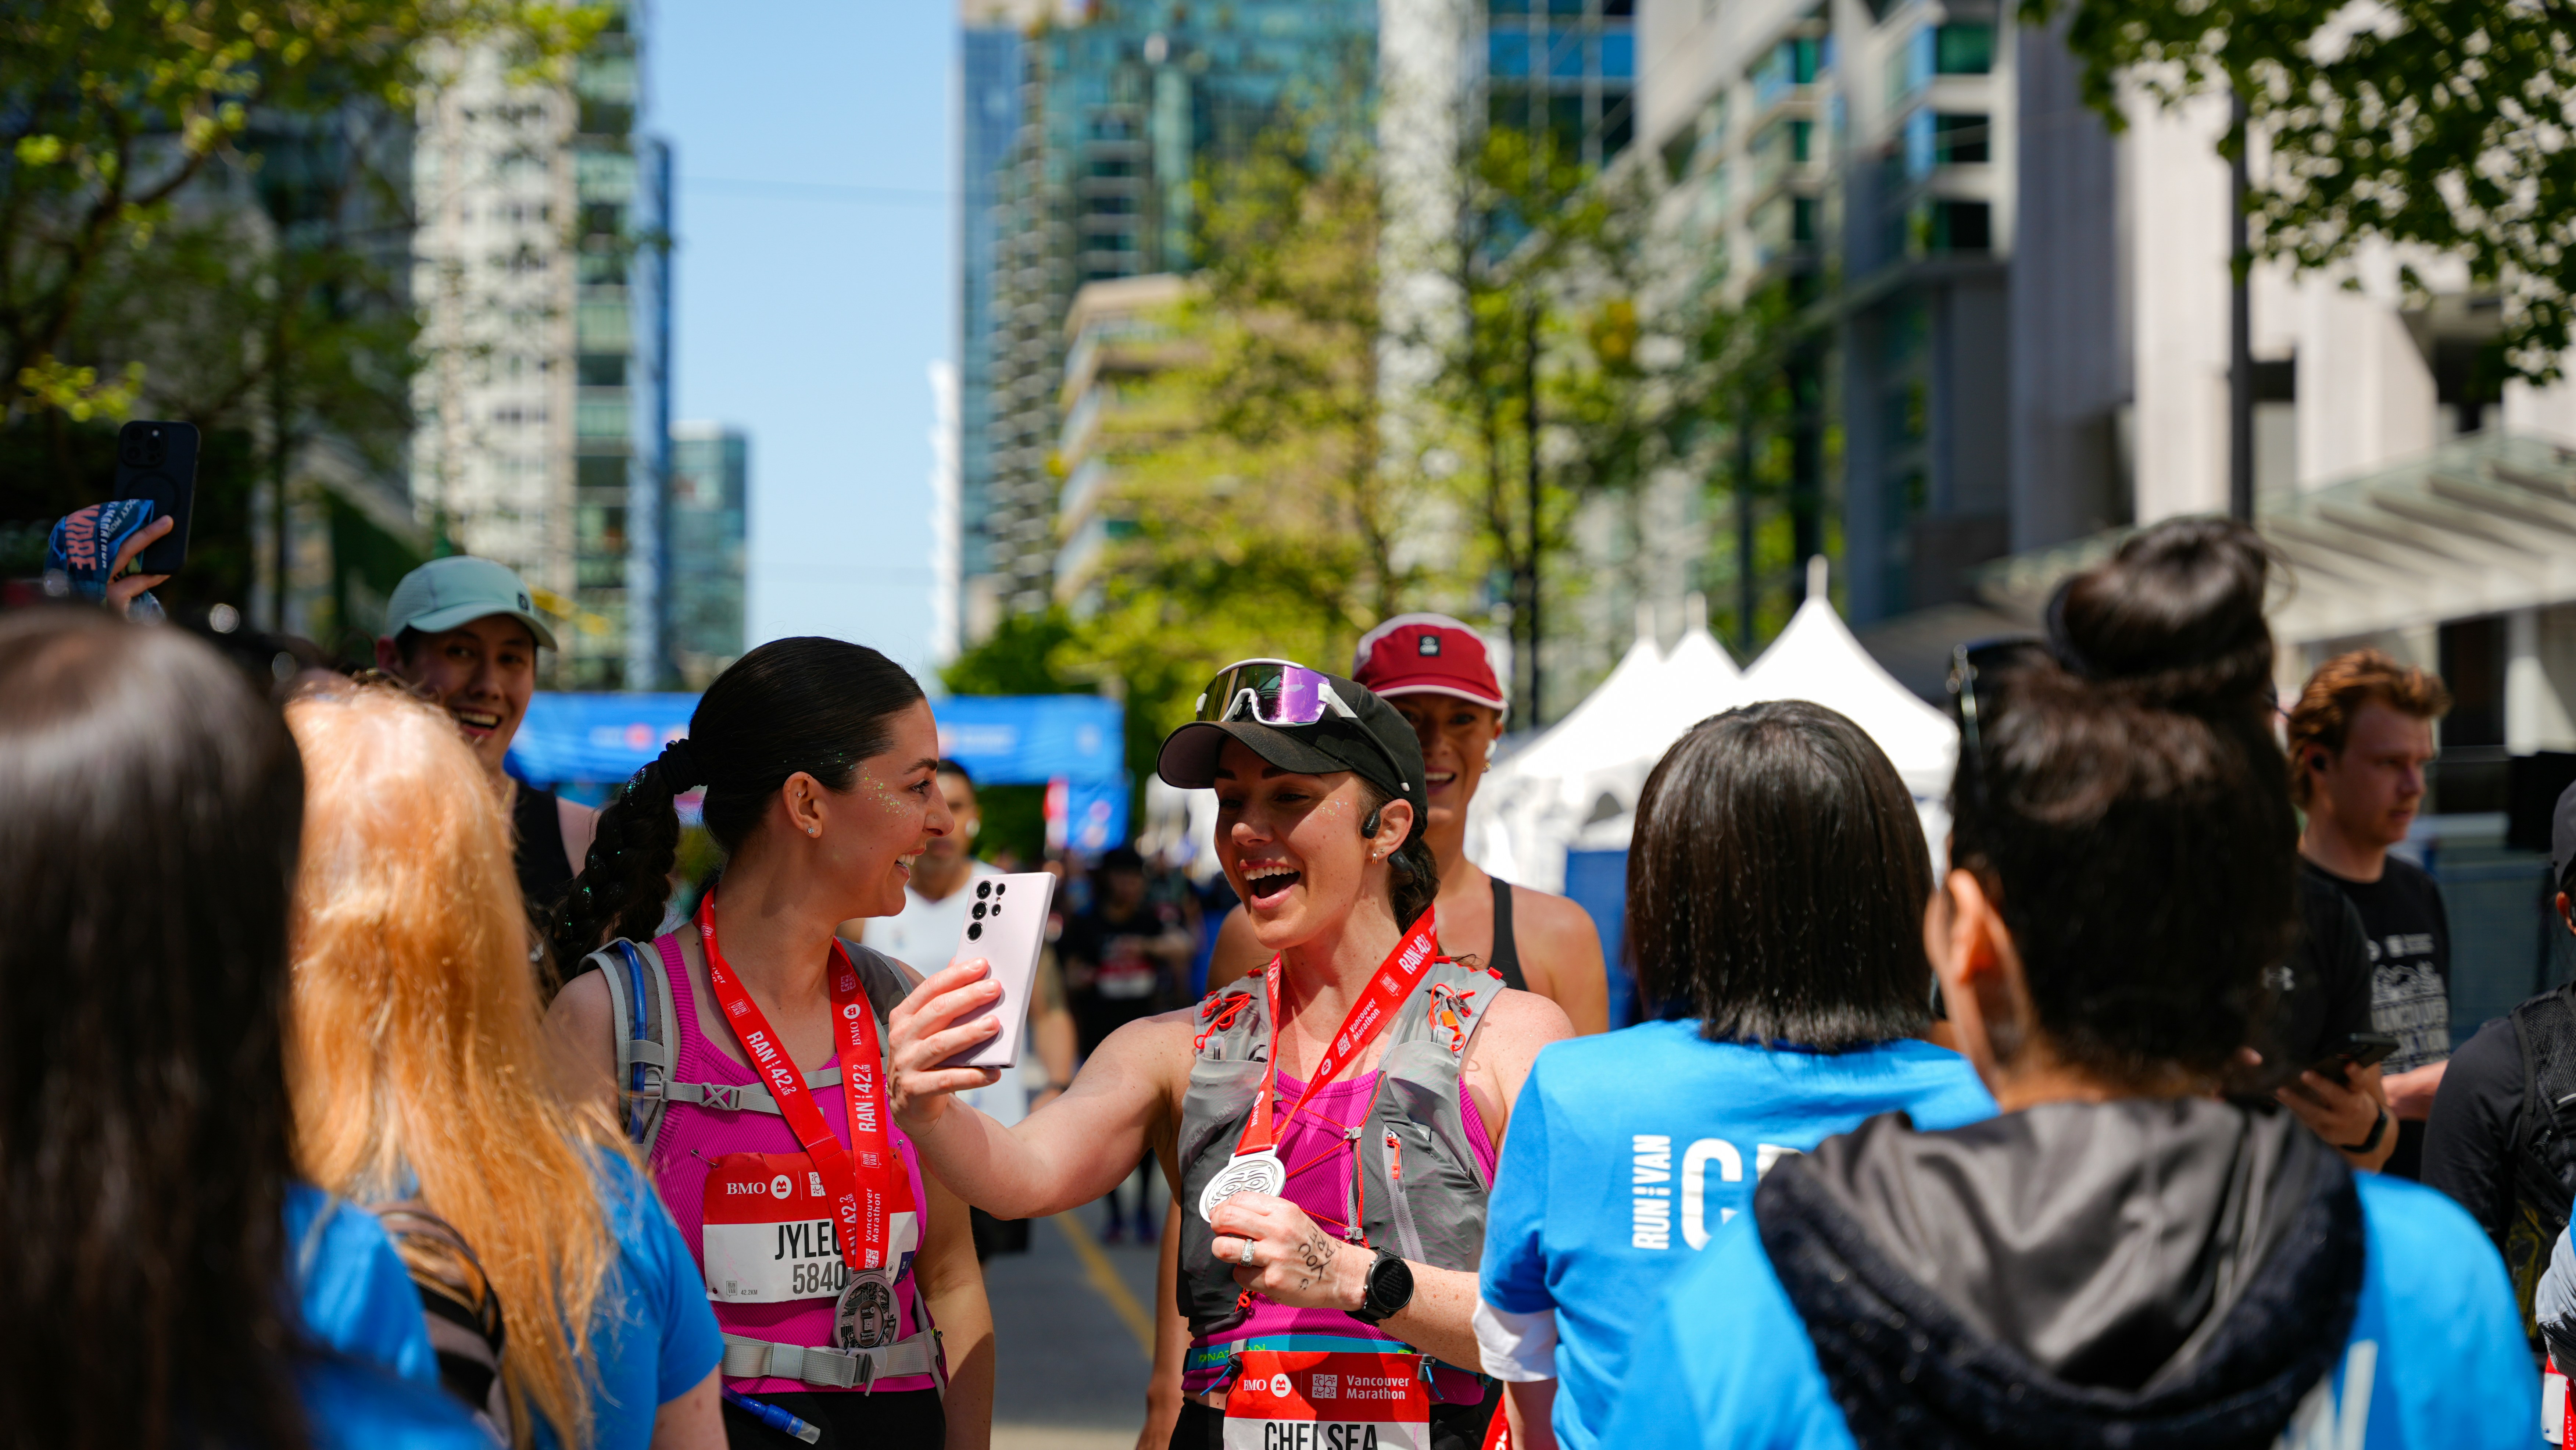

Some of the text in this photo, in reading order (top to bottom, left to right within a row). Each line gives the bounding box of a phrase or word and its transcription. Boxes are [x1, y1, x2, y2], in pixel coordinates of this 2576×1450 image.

[704, 925, 714, 936] VAN
[1398, 947, 1424, 975] RAN
[1382, 975, 1392, 988] RUN
[1388, 981, 1399, 993] VAN
[730, 1004, 741, 1016] VAN
[736, 1001, 748, 1013] RUN
[1349, 997, 1376, 1033] Vancouver
[848, 1021, 861, 1046] BMO
[1352, 1008, 1381, 1042] Marathon
[746, 1031, 777, 1063] RAN
[856, 1102, 877, 1132] RAN
[1189, 1101, 1234, 1147] SALOMON
[1250, 1105, 1260, 1128] BMO
[726, 1182, 766, 1194] BMO
[1632, 1134, 1671, 1250] RUN VAN
[872, 1193, 881, 1243] Marathon
[1309, 1226, 1336, 1258] ARE
[1298, 1243, 1331, 1282] YOU
[1208, 1343, 1266, 1361] NATN
[1243, 1379, 1267, 1391] BMO
[1346, 1375, 1410, 1387] Vancouver
[1346, 1389, 1406, 1400] Marathon
